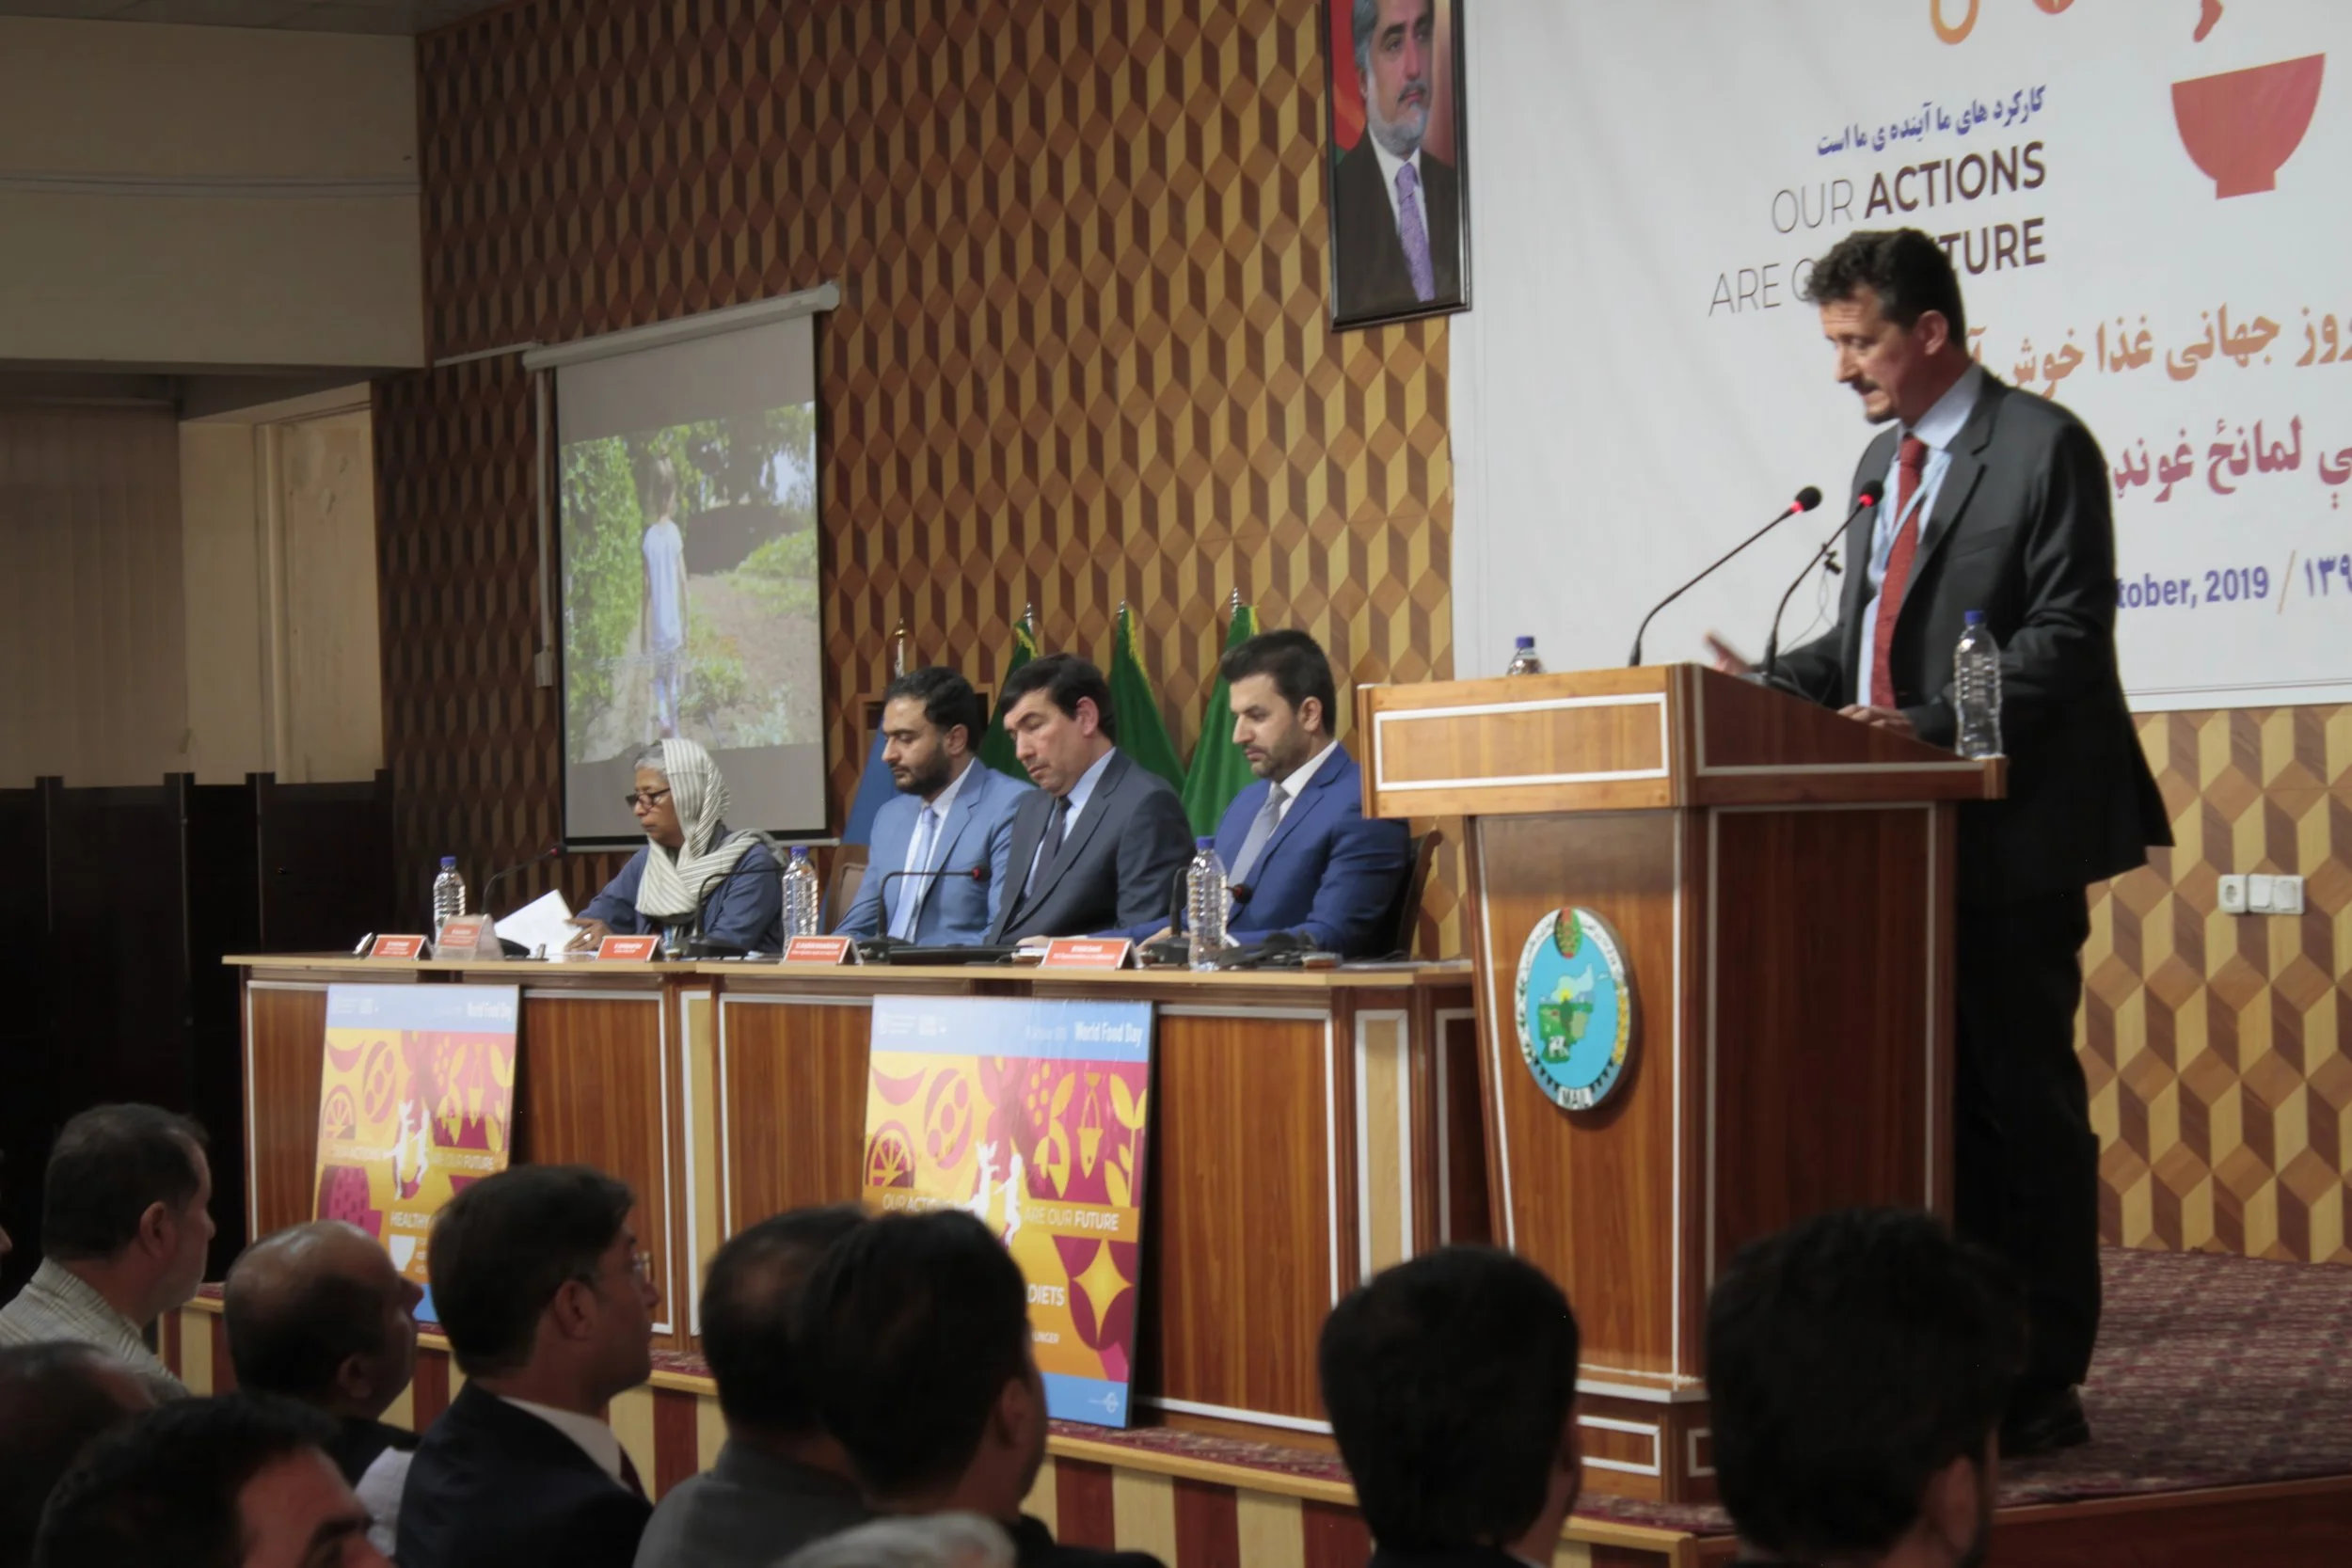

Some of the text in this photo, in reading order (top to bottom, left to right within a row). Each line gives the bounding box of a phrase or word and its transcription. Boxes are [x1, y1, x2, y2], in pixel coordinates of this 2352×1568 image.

[1936, 104, 1951, 132] ما
[1956, 99, 1988, 135] های
[1818, 125, 1850, 156] است
[1853, 123, 1867, 148] ما
[1772, 140, 2046, 234] OUR ACTIONS
[1708, 262, 1782, 317] ARE
[1935, 217, 2046, 276] TURE
[2096, 315, 2154, 374] غذا
[2166, 301, 2280, 382] جهانی
[2115, 565, 2269, 610] tober, 2019
[1047, 1208, 1073, 1227] OUR
[1074, 1210, 1120, 1232] FUTURE
[1026, 1282, 1065, 1307] DIETS
